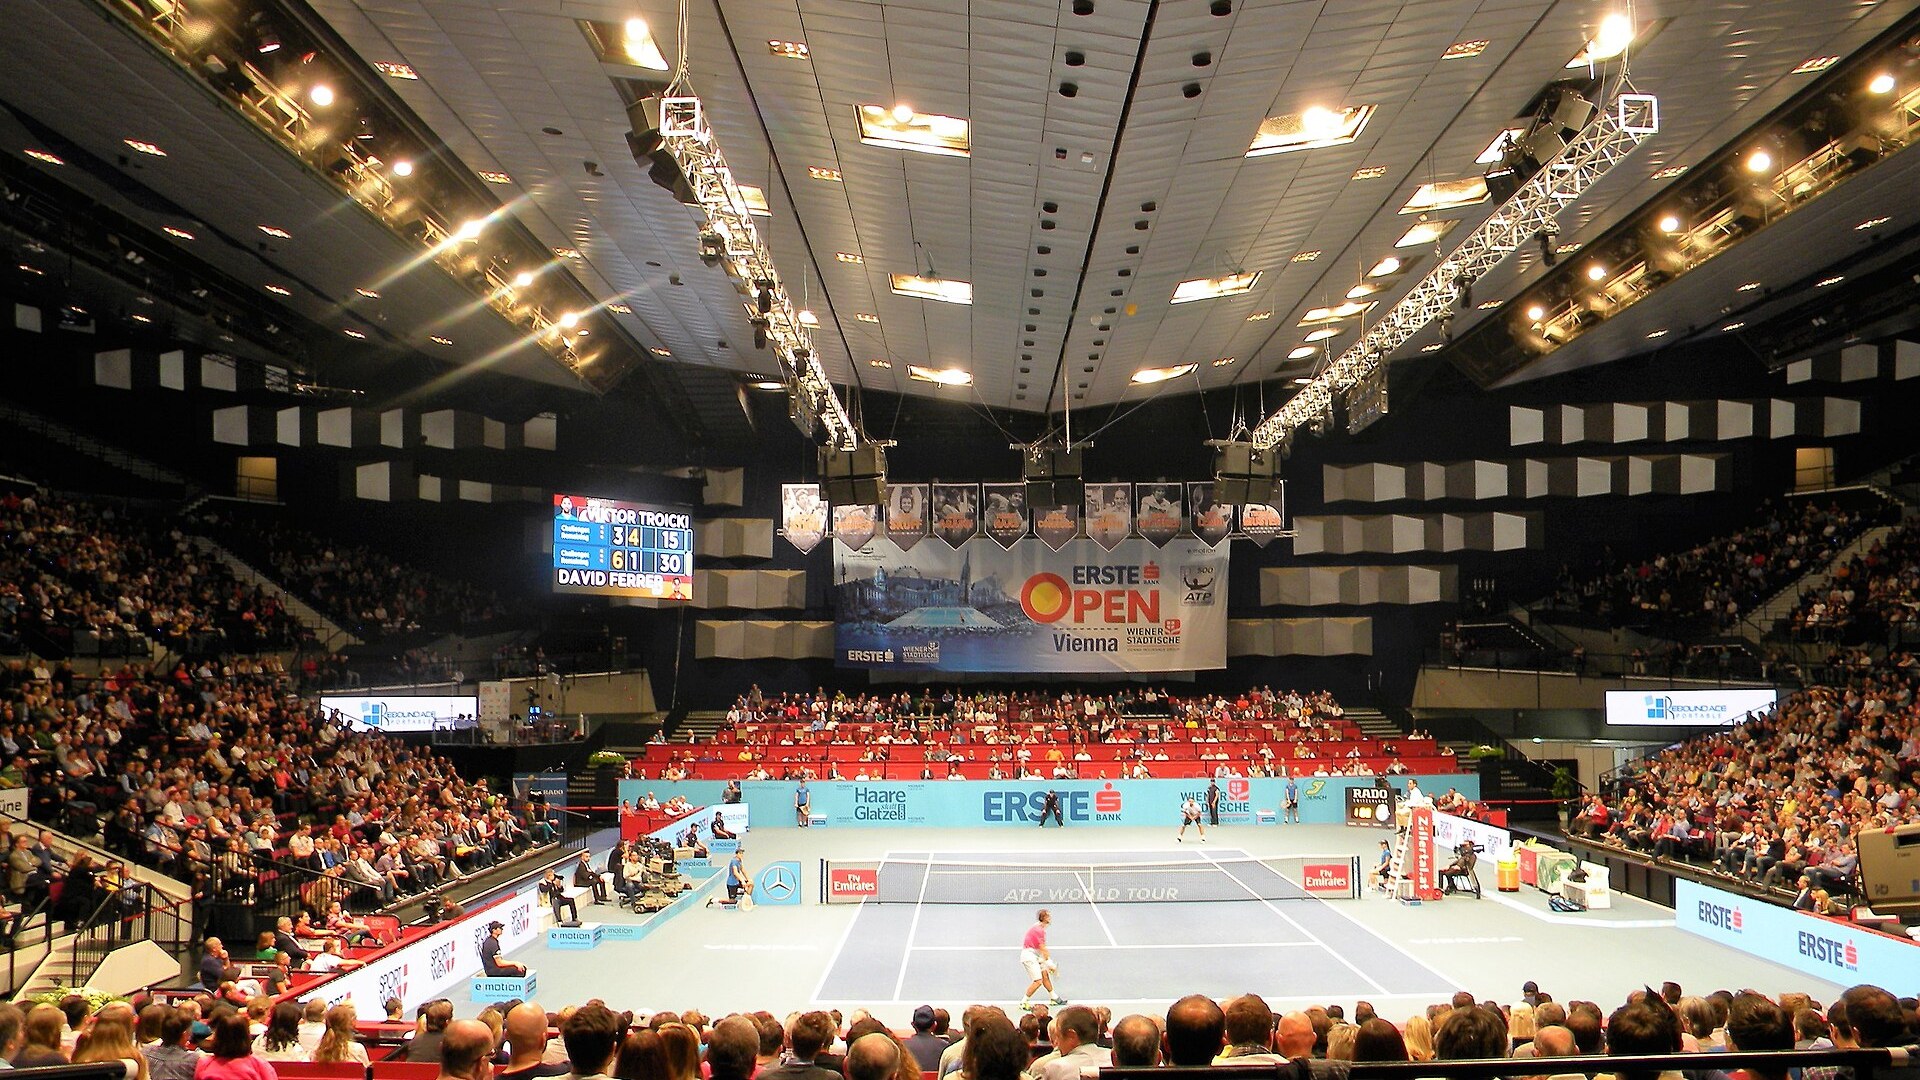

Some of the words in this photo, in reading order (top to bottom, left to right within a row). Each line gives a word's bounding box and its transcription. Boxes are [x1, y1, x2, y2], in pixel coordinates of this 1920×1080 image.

[638, 510, 689, 528] TROICKI
[613, 527, 623, 545] 3
[628, 528, 639, 546] 4
[661, 531, 679, 549] 15
[612, 551, 624, 569] 6
[630, 552, 637, 570] 1
[660, 554, 680, 573] 30
[558, 569, 606, 587] DAVID
[1073, 565, 1139, 584] ERSTE
[1020, 572, 1160, 624] OPEN
[1184, 593, 1212, 601] ATP
[1053, 633, 1118, 652] Vienna
[848, 650, 883, 661] ERSTE
[855, 787, 906, 803] Haare
[1352, 788, 1388, 799] RADO
[854, 805, 897, 820] Glatze
[1417, 815, 1430, 890] Zillertal.at
[833, 881, 875, 891] Emirates
[848, 874, 861, 882] Fly
[1305, 877, 1347, 887] Emirates
[1004, 889, 1042, 900] ATP
[1050, 888, 1120, 900] WORLD
[1127, 887, 1179, 900] TOUR
[1698, 900, 1731, 930] ERSTE
[560, 932, 590, 940] motion
[1798, 930, 1843, 967] ERSTE
[485, 982, 522, 991] motion
